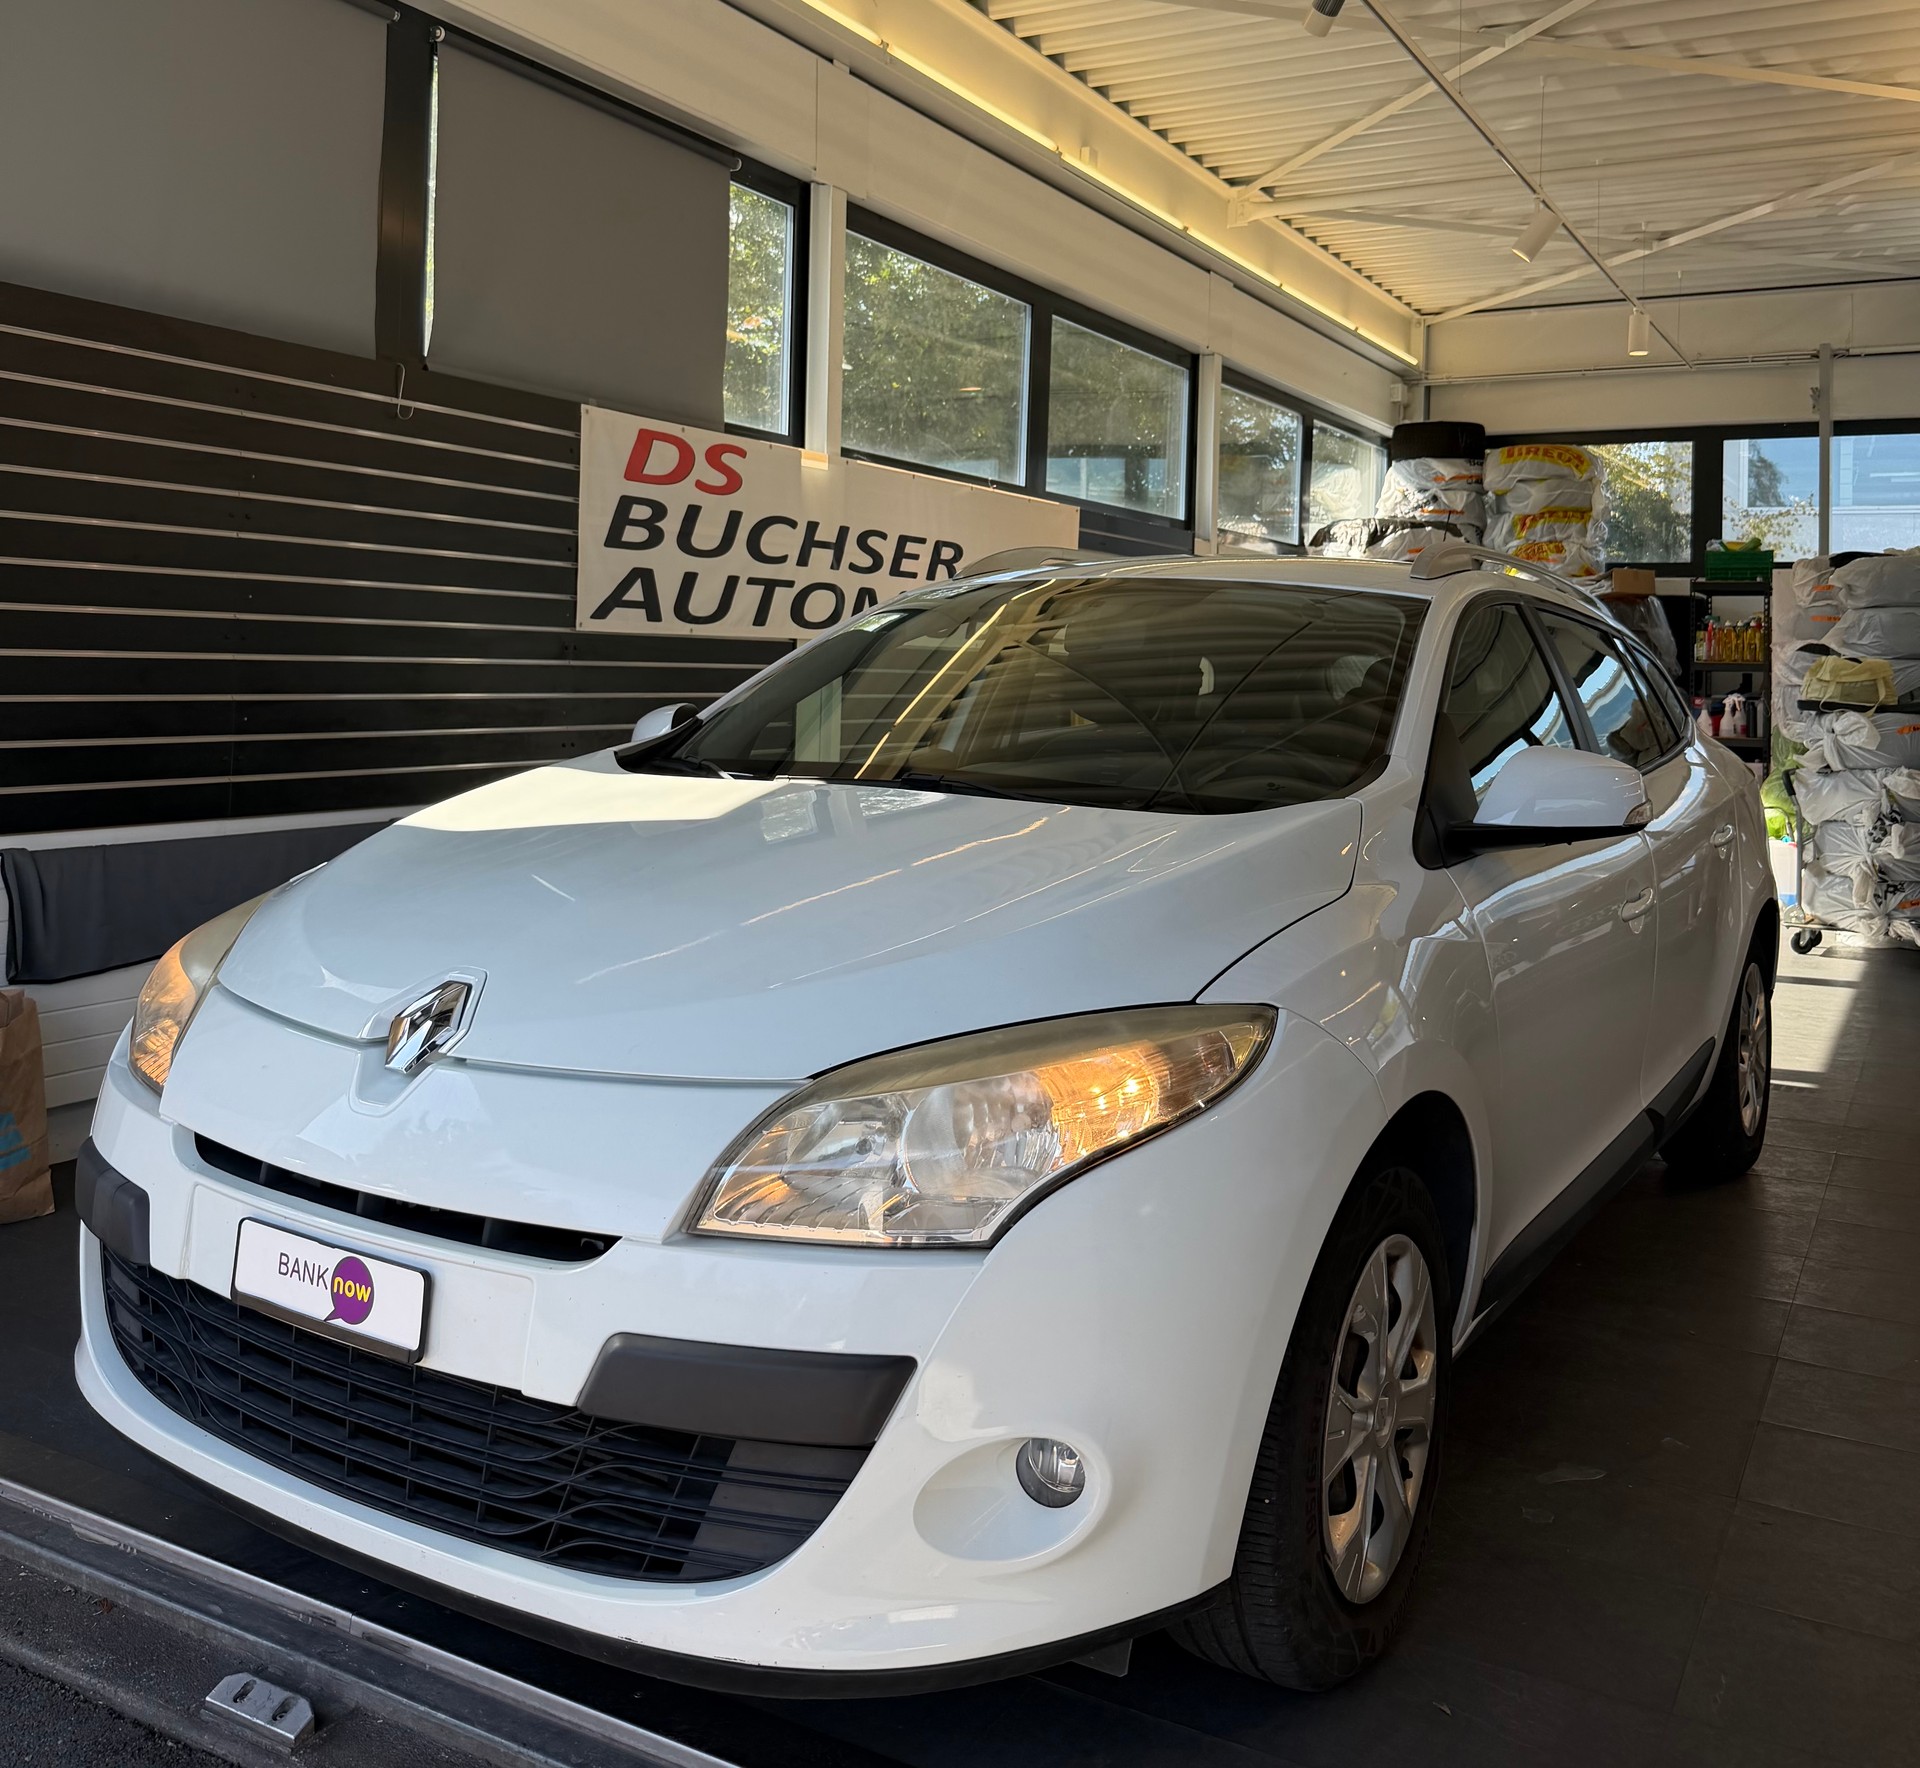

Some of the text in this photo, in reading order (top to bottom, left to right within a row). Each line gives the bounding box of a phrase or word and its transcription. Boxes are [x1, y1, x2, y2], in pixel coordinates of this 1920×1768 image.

[623, 428, 748, 496] DS
[603, 495, 964, 582] BUCHSER
[278, 1252, 372, 1303] BANK now
